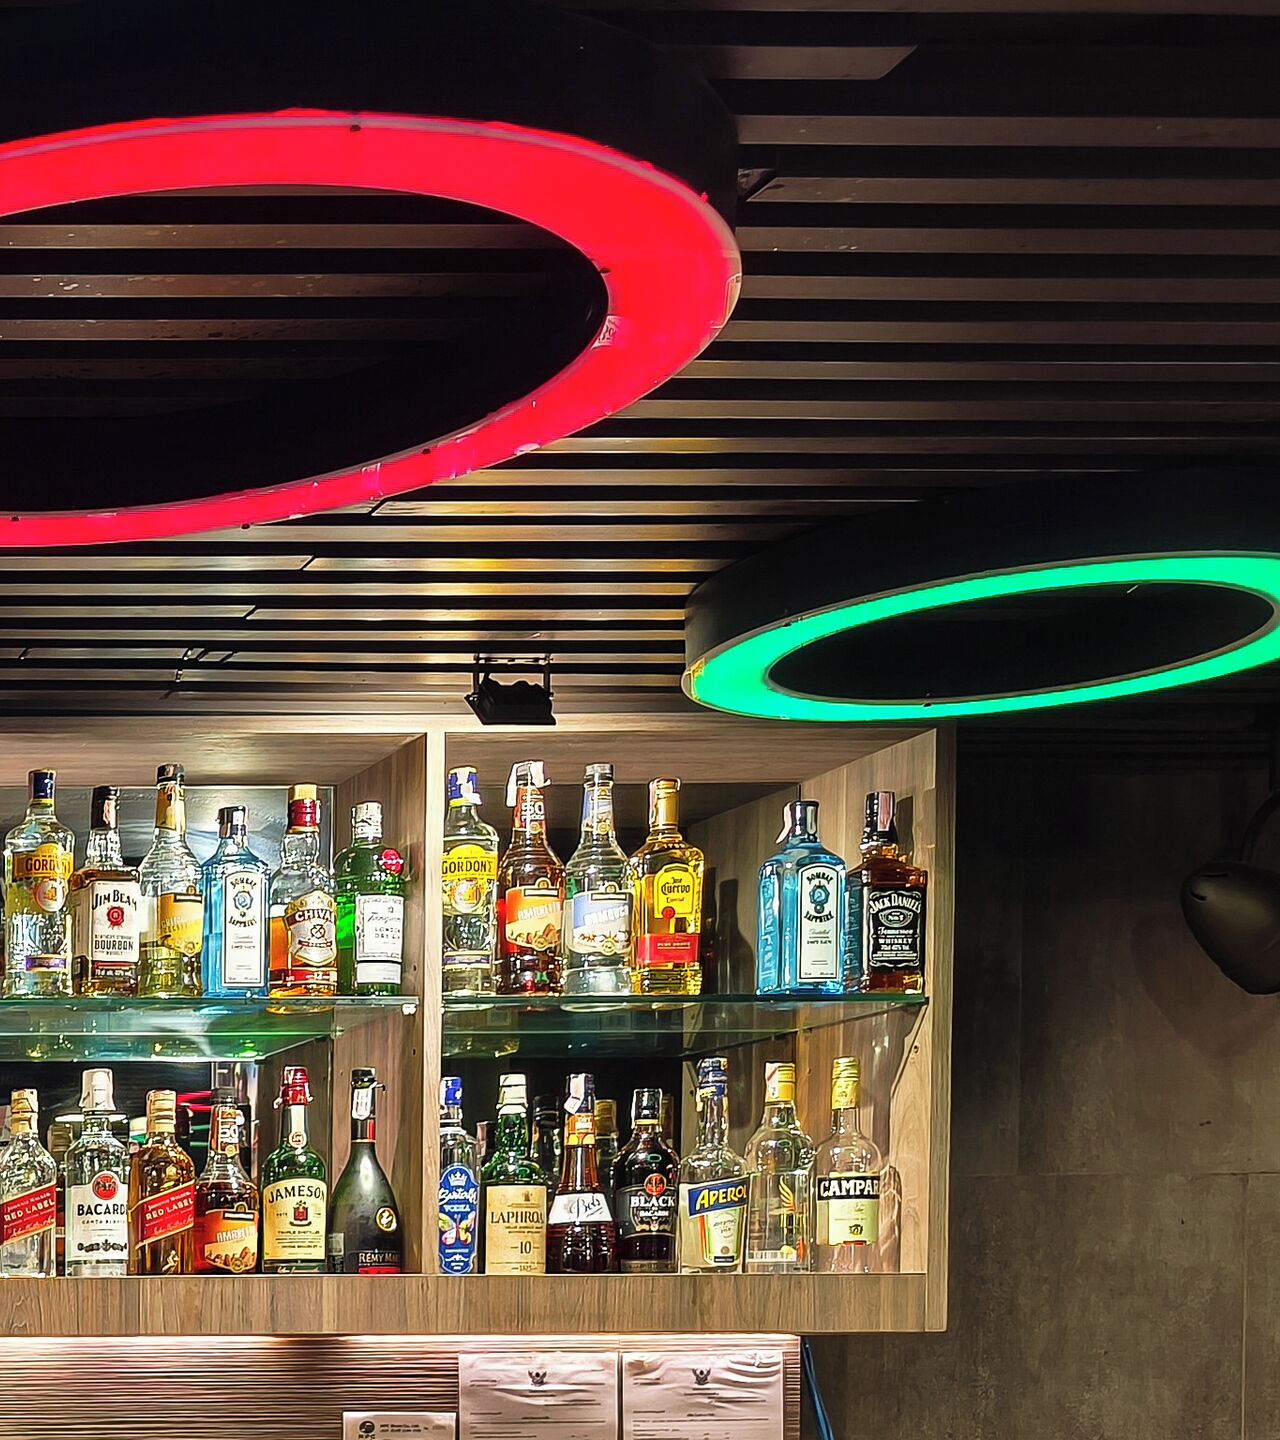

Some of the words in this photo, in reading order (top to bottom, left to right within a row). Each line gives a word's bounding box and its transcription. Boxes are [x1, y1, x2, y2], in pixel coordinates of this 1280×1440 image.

[660, 883, 691, 895] Cuervo
[92, 893, 111, 910] JIM
[869, 896, 889, 914] JACK
[94, 940, 134, 951] BOURBON
[820, 1179, 880, 1196] CAMPAR
[146, 1209, 164, 1220] RED
[166, 1197, 194, 1214] LABEL
[630, 1196, 675, 1207] BLACK
[4, 1210, 24, 1222] RED
[25, 1199, 55, 1214] LABEL
[77, 1203, 128, 1216] BACARD
[520, 1241, 532, 1254] 10
